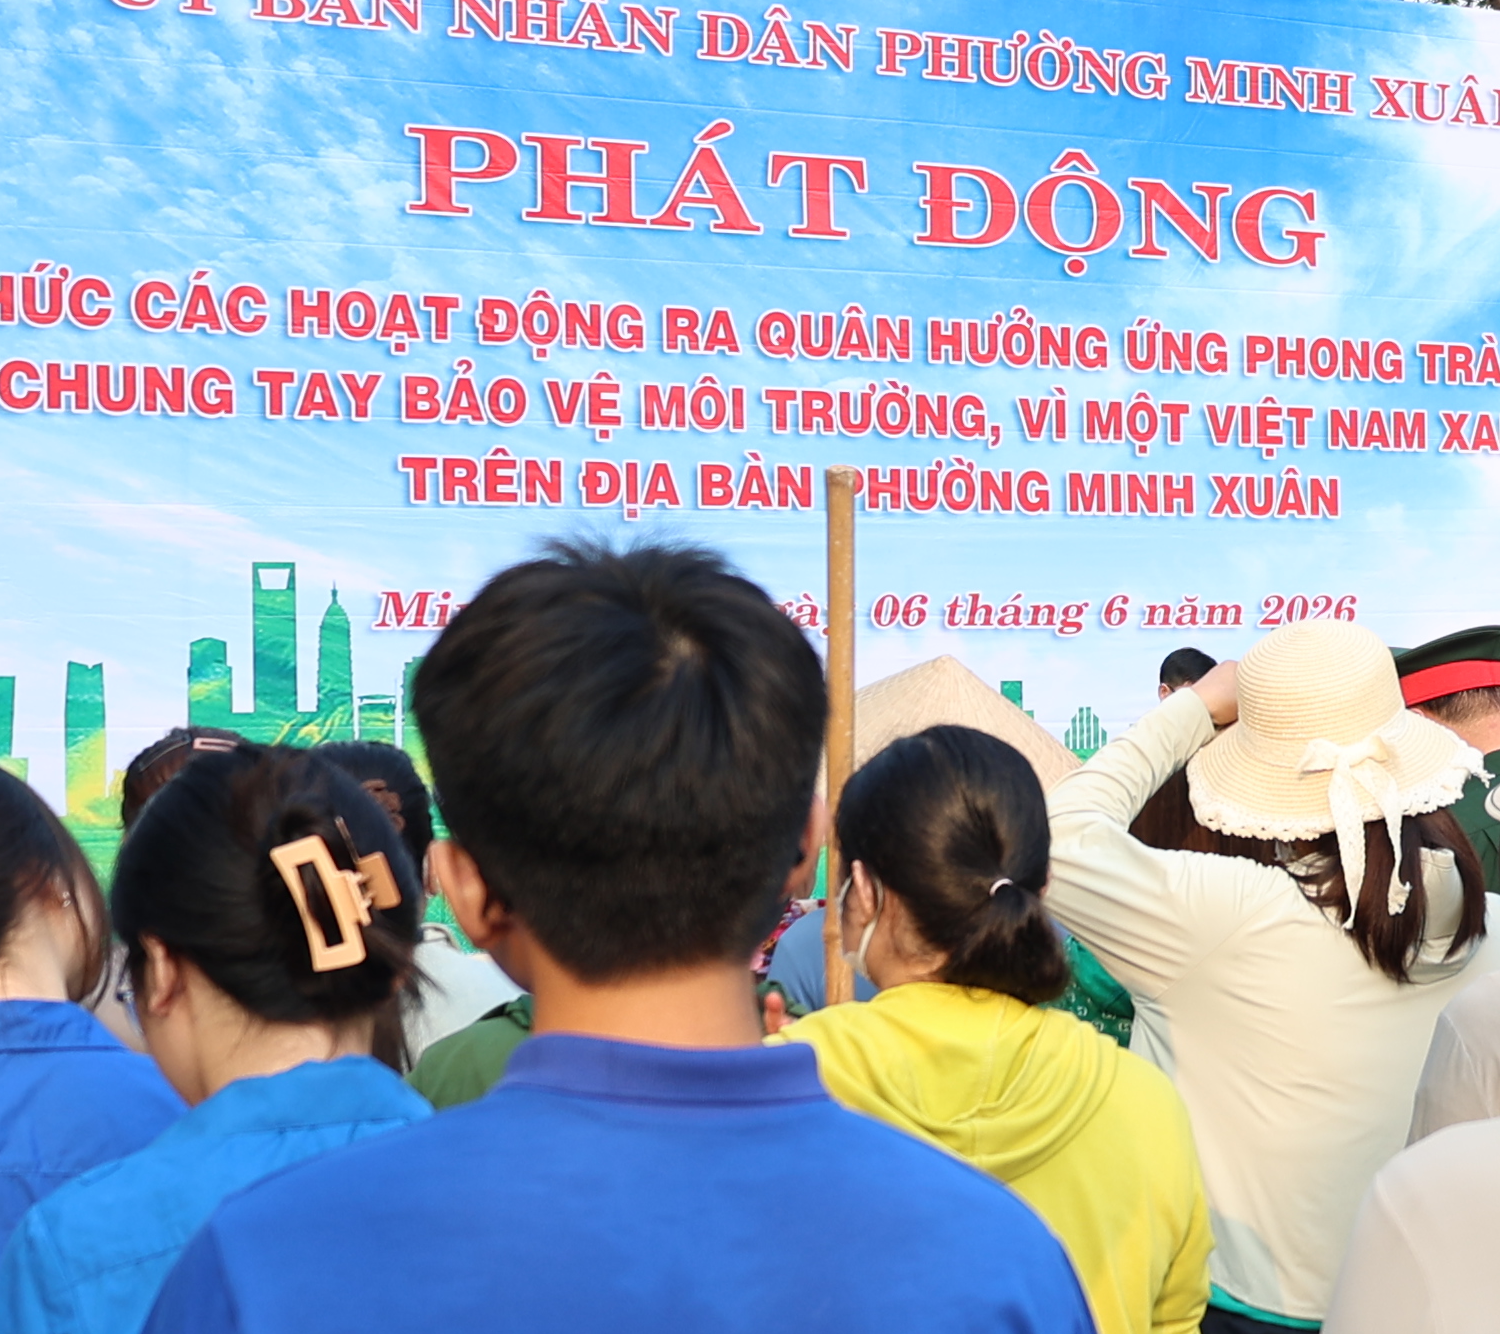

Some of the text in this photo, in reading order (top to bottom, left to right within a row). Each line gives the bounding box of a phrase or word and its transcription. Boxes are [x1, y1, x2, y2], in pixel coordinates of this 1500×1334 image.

[700, 5, 858, 70] DÂN
[878, 29, 1169, 98] PHƯỜNG
[1188, 58, 1354, 115] MINH
[406, 120, 1328, 276] PHÁT ĐỘNG
[132, 269, 269, 335] CÁC
[289, 287, 462, 354] HOẠT
[477, 288, 646, 360] ĐỘNG
[664, 306, 742, 354] RA
[757, 304, 912, 361] QUÂN
[929, 306, 1110, 370] HƯỞNG
[1125, 317, 1230, 375] ỨNG
[1245, 333, 1405, 382] PHONG
[255, 368, 383, 420] TAY
[403, 357, 529, 426] BẢO
[545, 370, 624, 441] VỆ
[642, 374, 746, 432] MÔI
[763, 379, 1003, 448] TRƯỜNG,
[1017, 385, 1068, 441] VÌ
[1084, 390, 1191, 455] MỘT
[1205, 395, 1315, 459] VIỆT
[1329, 407, 1428, 451] NAM
[399, 445, 564, 505] TRÊN
[580, 459, 682, 519] ĐỊA
[699, 450, 814, 509] BÀN
[1067, 471, 1196, 516] MINH
[1210, 466, 1341, 518] XUÂN
[872, 593, 930, 628] 06
[945, 591, 1091, 636] tháng
[1102, 593, 1131, 627] 6
[1143, 596, 1244, 628] năm
[1258, 593, 1359, 626] 2026
